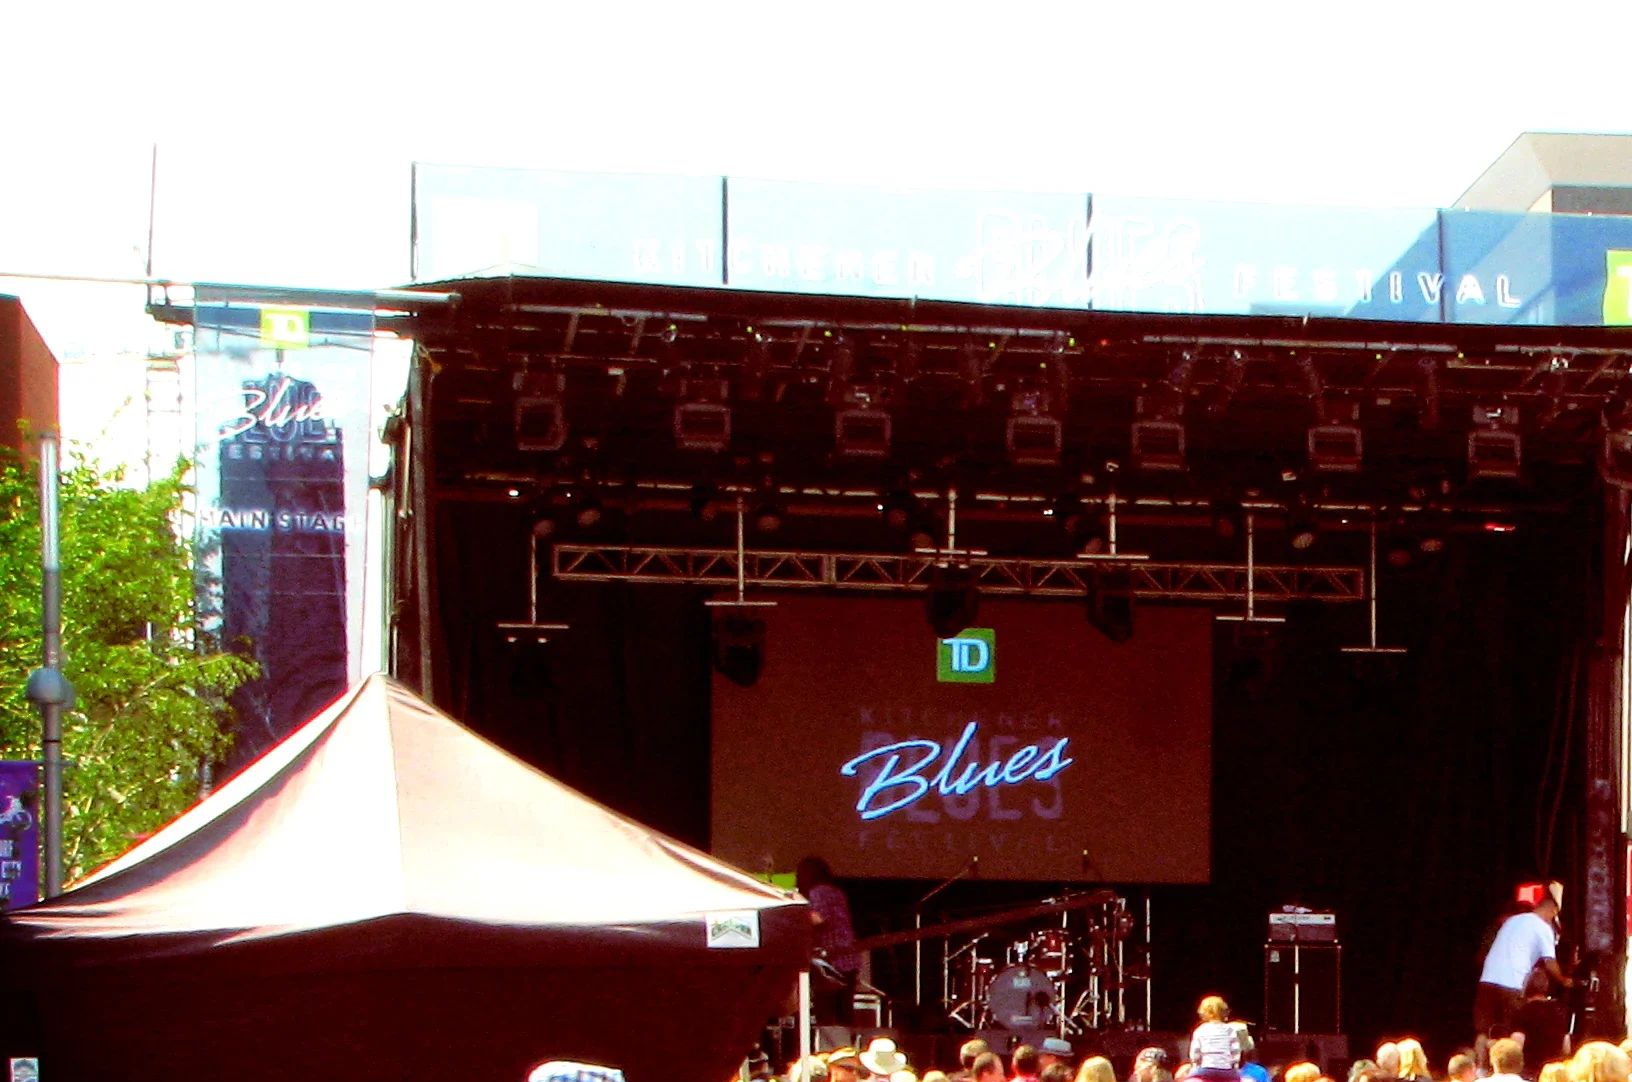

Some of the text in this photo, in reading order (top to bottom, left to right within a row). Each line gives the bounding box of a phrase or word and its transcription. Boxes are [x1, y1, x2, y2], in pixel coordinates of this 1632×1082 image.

[1232, 264, 1524, 308] FESTIVAL
[942, 637, 990, 671] TD
[840, 721, 1074, 820] Blues
